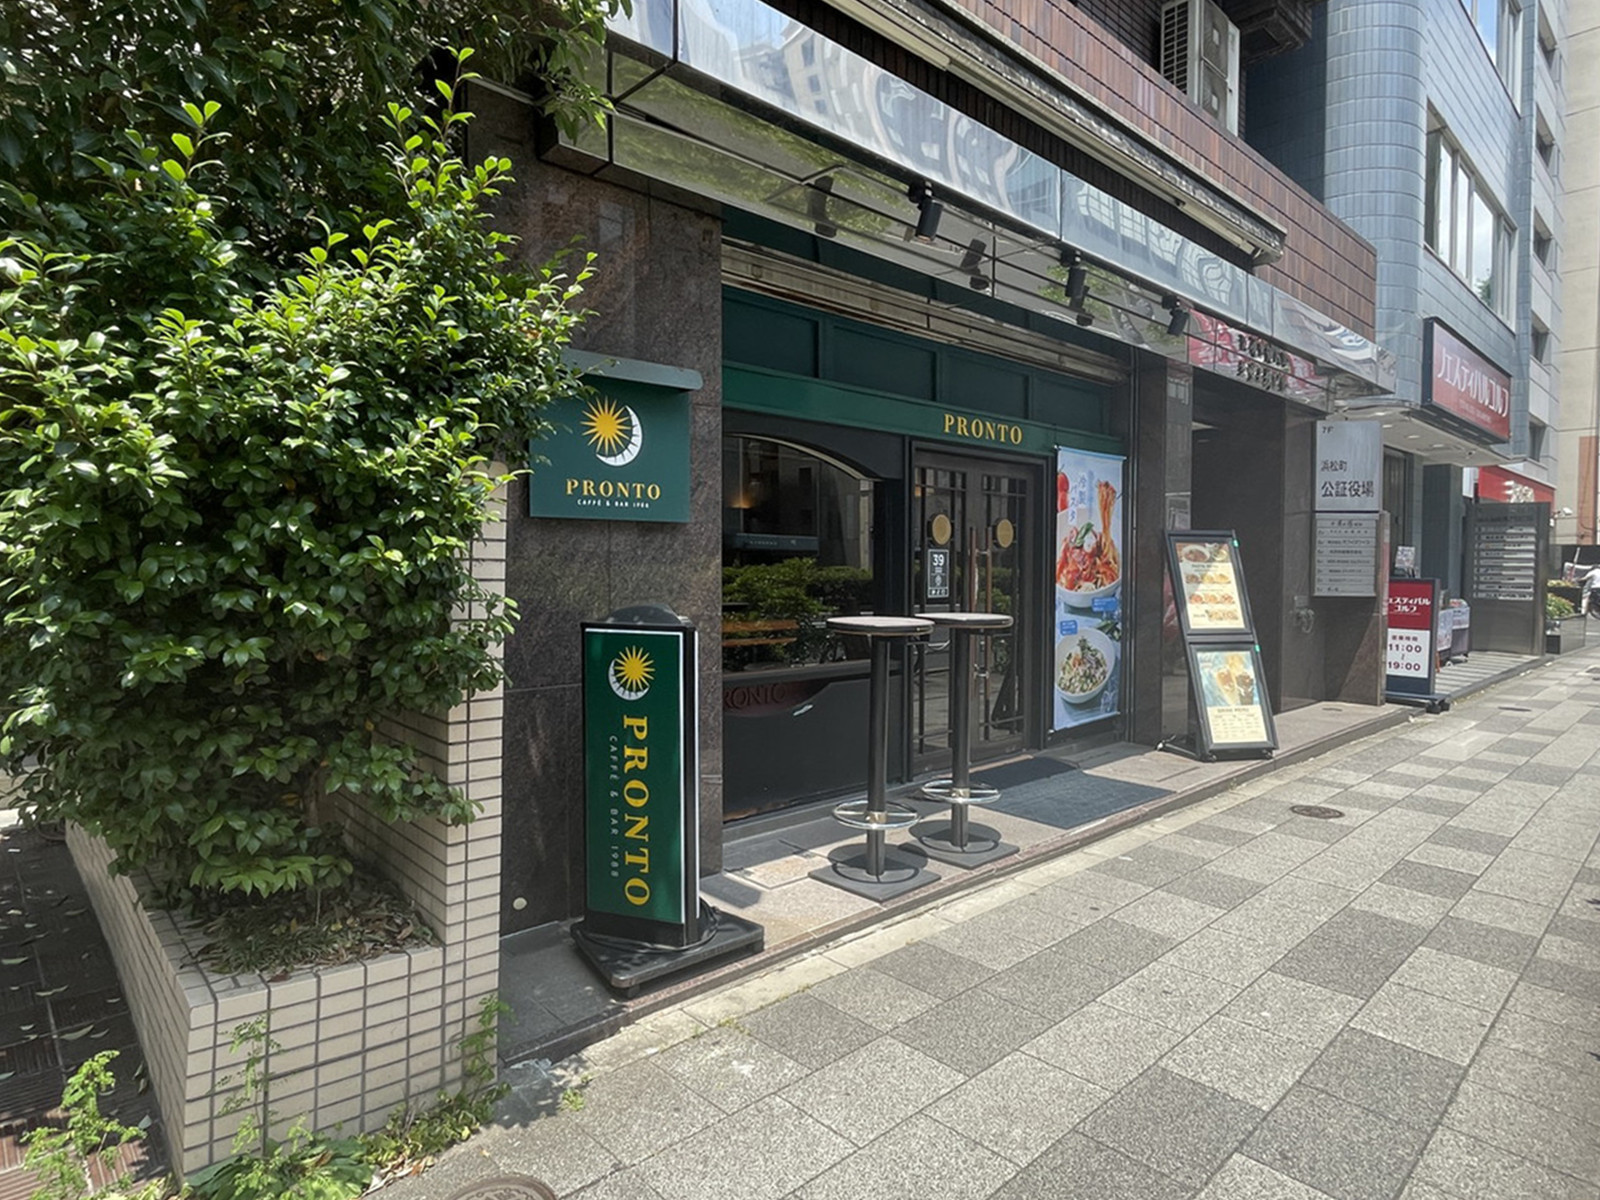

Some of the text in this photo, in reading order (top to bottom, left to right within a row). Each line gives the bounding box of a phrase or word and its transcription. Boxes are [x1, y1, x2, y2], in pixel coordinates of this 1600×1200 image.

[944, 413, 1022, 445] PRONTO
[1321, 460, 1347, 472] 浜松町
[566, 478, 661, 500] PRONTO
[1321, 481, 1374, 497] 公証役場
[932, 554, 945, 566] 39
[1389, 643, 1422, 653] 11:00
[1388, 661, 1421, 671] 19:00
[723, 683, 786, 710] RONTO
[610, 790, 618, 798] &
[623, 714, 650, 906] PRONTO
[610, 808, 619, 835] BAR
[610, 845, 619, 878] 1988
